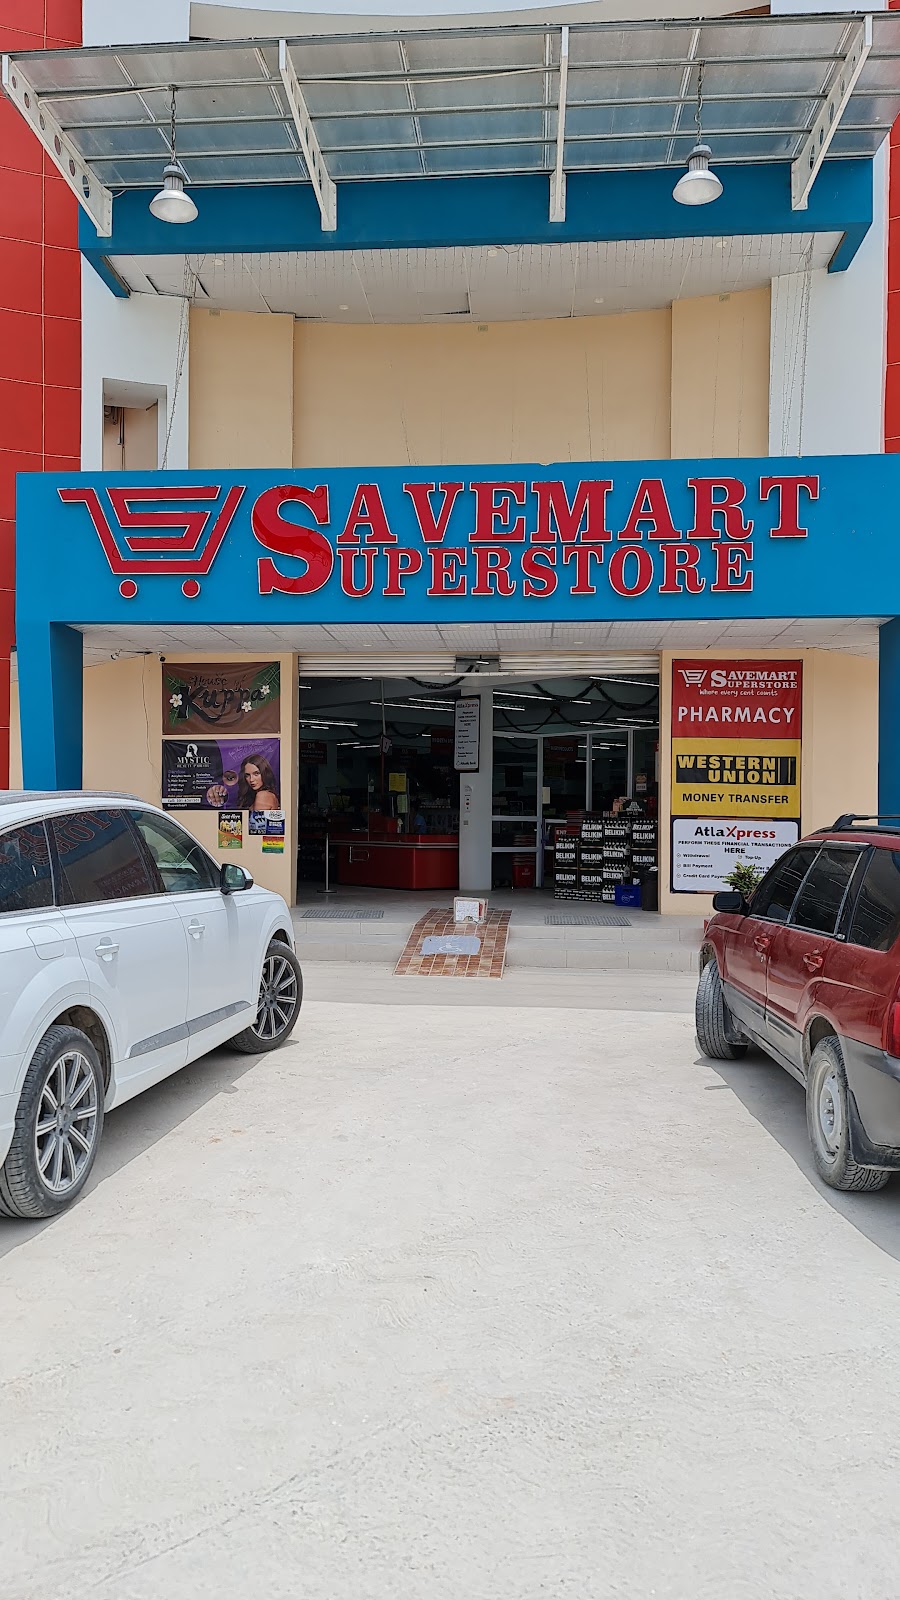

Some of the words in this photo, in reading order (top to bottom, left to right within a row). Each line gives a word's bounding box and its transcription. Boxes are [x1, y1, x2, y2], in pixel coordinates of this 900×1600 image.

[251, 475, 820, 595] SAVEMART
[190, 672, 228, 687] House
[710, 670, 798, 687] SAVEMART
[756, 689, 778, 697] counts
[176, 686, 266, 723] Kuppa
[677, 706, 795, 724] PHARMACY
[177, 756, 210, 764] MYSTIC
[677, 755, 776, 771] WESTERN
[708, 769, 776, 784] UNION
[682, 793, 725, 802] MONEY
[728, 794, 789, 804] TRANSFER
[582, 823, 603, 831] BELIKIN
[581, 831, 603, 839] BELIKIN
[604, 828, 625, 836] BELIKIN
[632, 832, 656, 840] BELIKIN
[694, 825, 776, 841] AtlaXpress
[555, 852, 576, 860] BELIKIN
[581, 852, 603, 861] BELIKIN
[603, 850, 624, 858] BELIKIN
[632, 855, 656, 864] BELIKIN
[602, 872, 624, 880] BELIKIN
